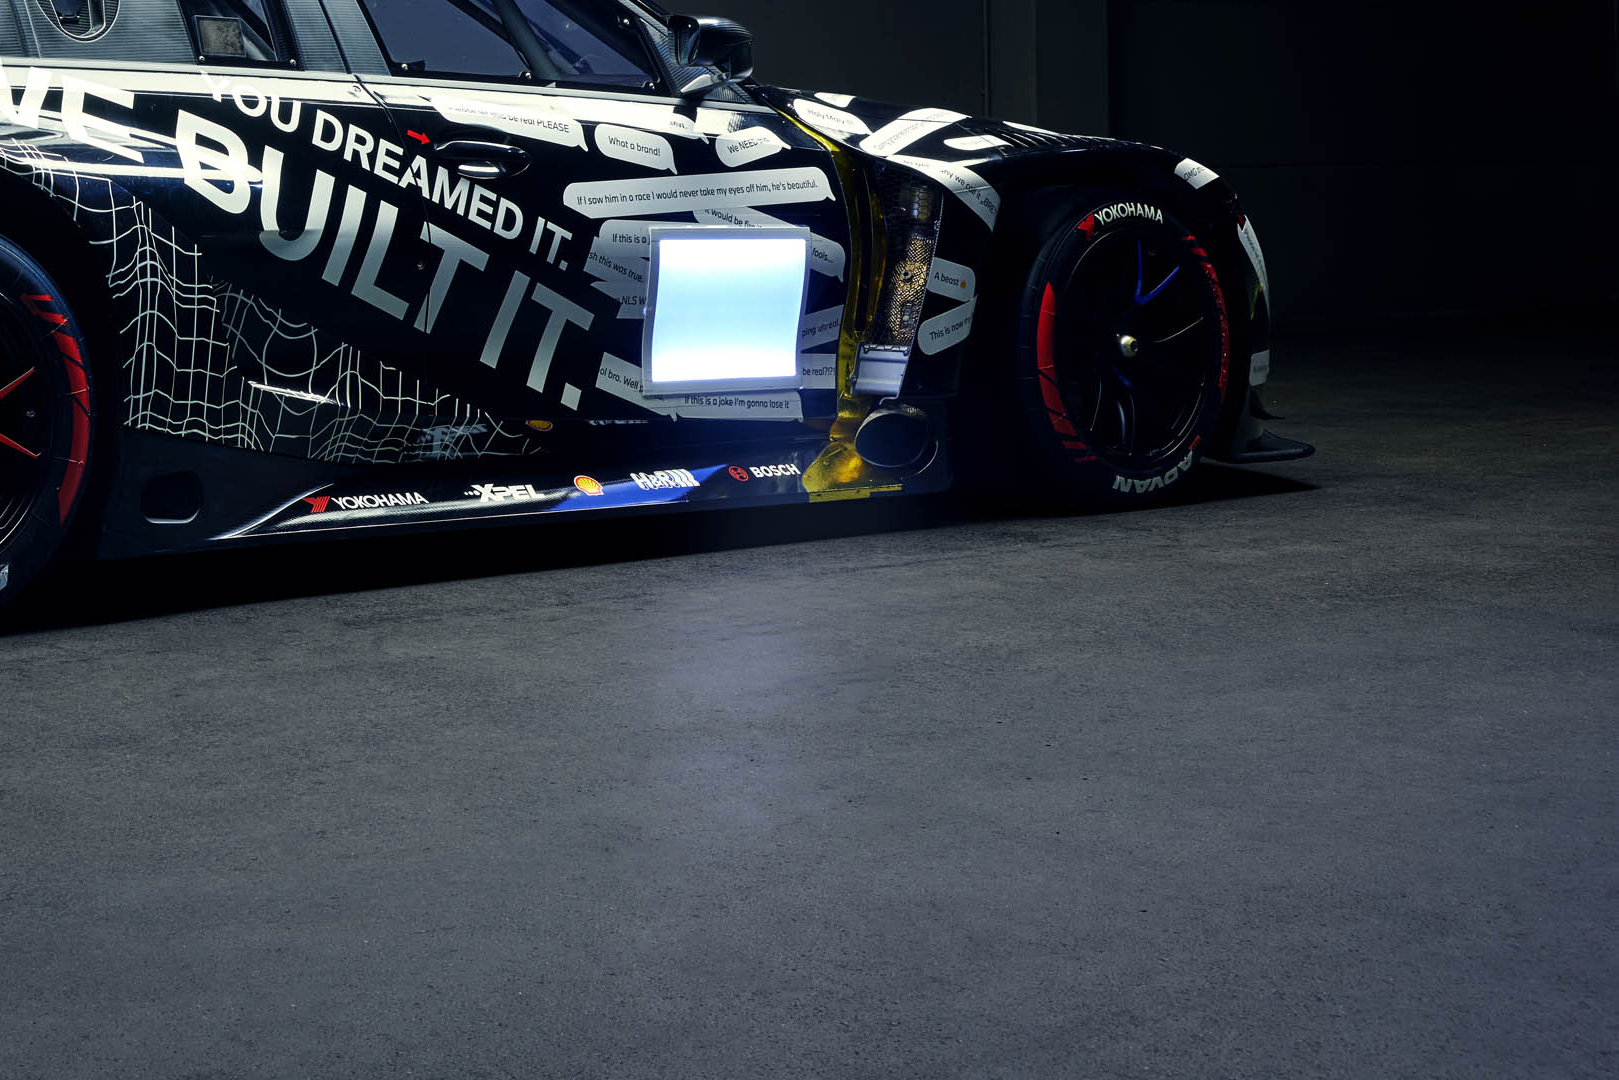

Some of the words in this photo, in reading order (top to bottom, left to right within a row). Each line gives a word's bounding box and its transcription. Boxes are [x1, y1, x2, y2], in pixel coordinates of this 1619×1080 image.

[537, 118, 570, 133] PLEASE
[608, 136, 629, 149] What
[727, 144, 739, 154] We
[200, 70, 302, 133] YOU
[312, 118, 525, 241] DREAMED
[528, 216, 573, 271] IT.
[588, 197, 604, 205] saw
[604, 194, 619, 204] him
[620, 193, 627, 203] in
[635, 193, 651, 202] race
[656, 189, 678, 200] would
[679, 189, 699, 198] never
[700, 187, 715, 197] take
[716, 188, 728, 197] my
[728, 186, 745, 195] eyes
[745, 184, 755, 193] off
[756, 183, 772, 193] him,
[772, 181, 786, 191] he's
[787, 180, 818, 190] beautiful.
[1094, 202, 1164, 225] YOKOHAMA
[619, 233, 633, 244] this
[633, 233, 641, 244] is
[641, 236, 647, 244] a
[177, 109, 489, 336] BUILT
[479, 270, 594, 411] IT.
[598, 255, 613, 269] this
[612, 263, 627, 276] was
[934, 271, 940, 281] A
[940, 273, 959, 287] beast
[929, 329, 944, 341] This
[944, 325, 951, 335] is
[608, 369, 622, 383] bro.
[623, 376, 639, 390] Well
[802, 367, 811, 376] be
[691, 394, 704, 405] this
[704, 395, 711, 406] is
[712, 398, 718, 406] a
[718, 396, 734, 407] joke
[734, 396, 746, 407] I'm
[746, 399, 768, 409] gonna
[769, 399, 784, 409] lose
[784, 399, 790, 409] it
[1112, 449, 1194, 494] ADVAN
[332, 491, 429, 510] YOKOHAMA
[471, 483, 545, 503] XPEL
[749, 463, 802, 478] BOSCH
